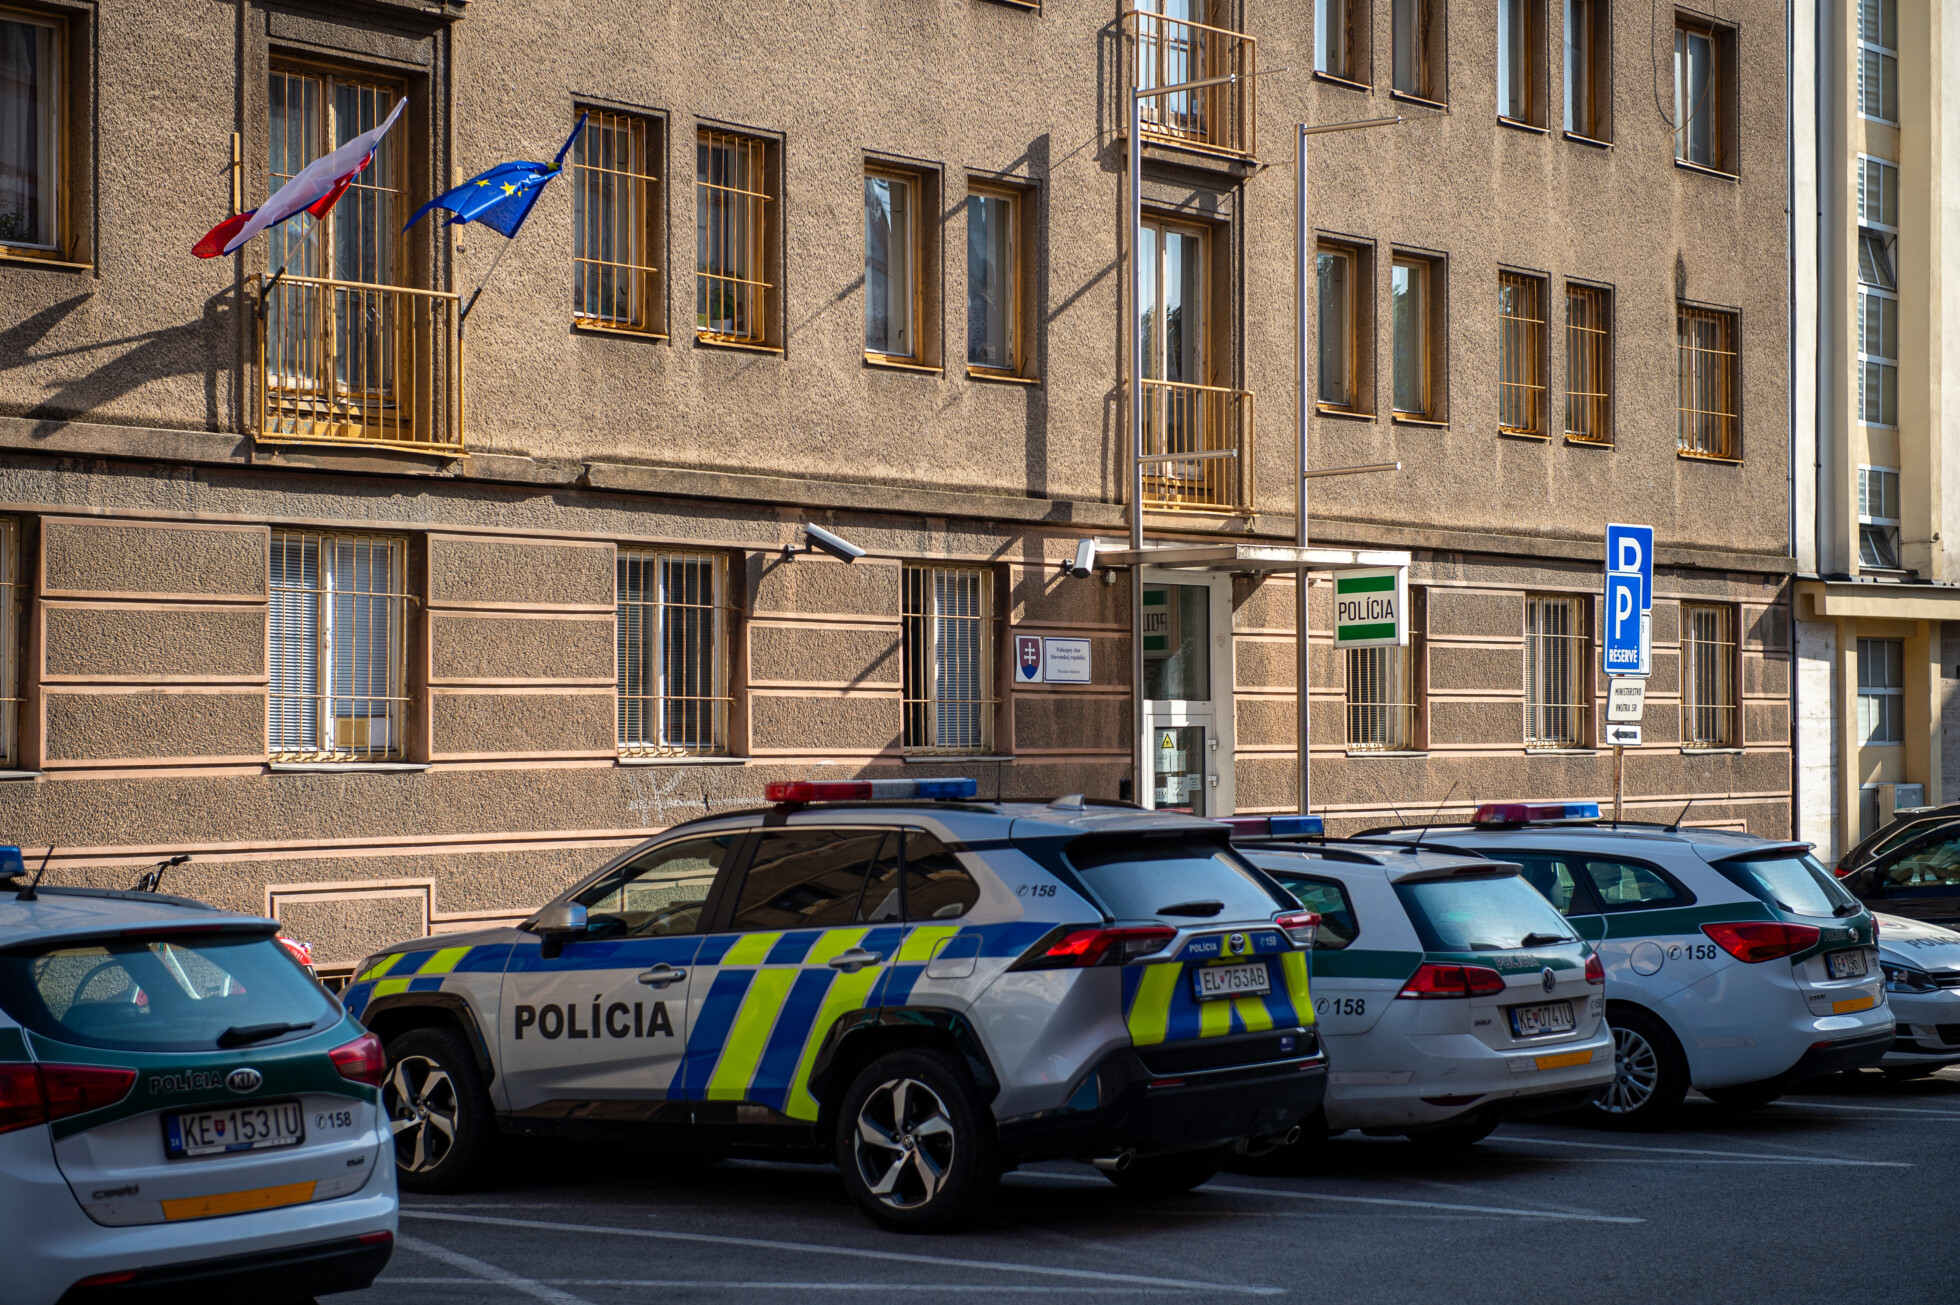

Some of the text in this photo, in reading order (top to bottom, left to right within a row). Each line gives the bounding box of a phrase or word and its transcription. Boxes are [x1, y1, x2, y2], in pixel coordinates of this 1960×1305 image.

[1338, 596, 1394, 621] POLÍCIA
[1616, 585, 1633, 639] P
[1609, 645, 1637, 663] RÉSERVÉ
[1615, 687, 1642, 696] MINISTERSTVO
[1031, 884, 1057, 897] 158
[1189, 942, 1217, 953] POLÍCIA
[1685, 944, 1717, 960] 158
[1203, 967, 1265, 991] EL 753AB
[1333, 998, 1365, 1016] 158
[515, 994, 674, 1040] POLÍCIA
[1518, 1009, 1534, 1029] KE
[150, 1070, 223, 1093] POLÍCIA
[233, 1073, 259, 1087] KIA
[182, 1115, 214, 1147] KE
[229, 1105, 299, 1142] 153IU
[328, 1111, 352, 1129] 158
